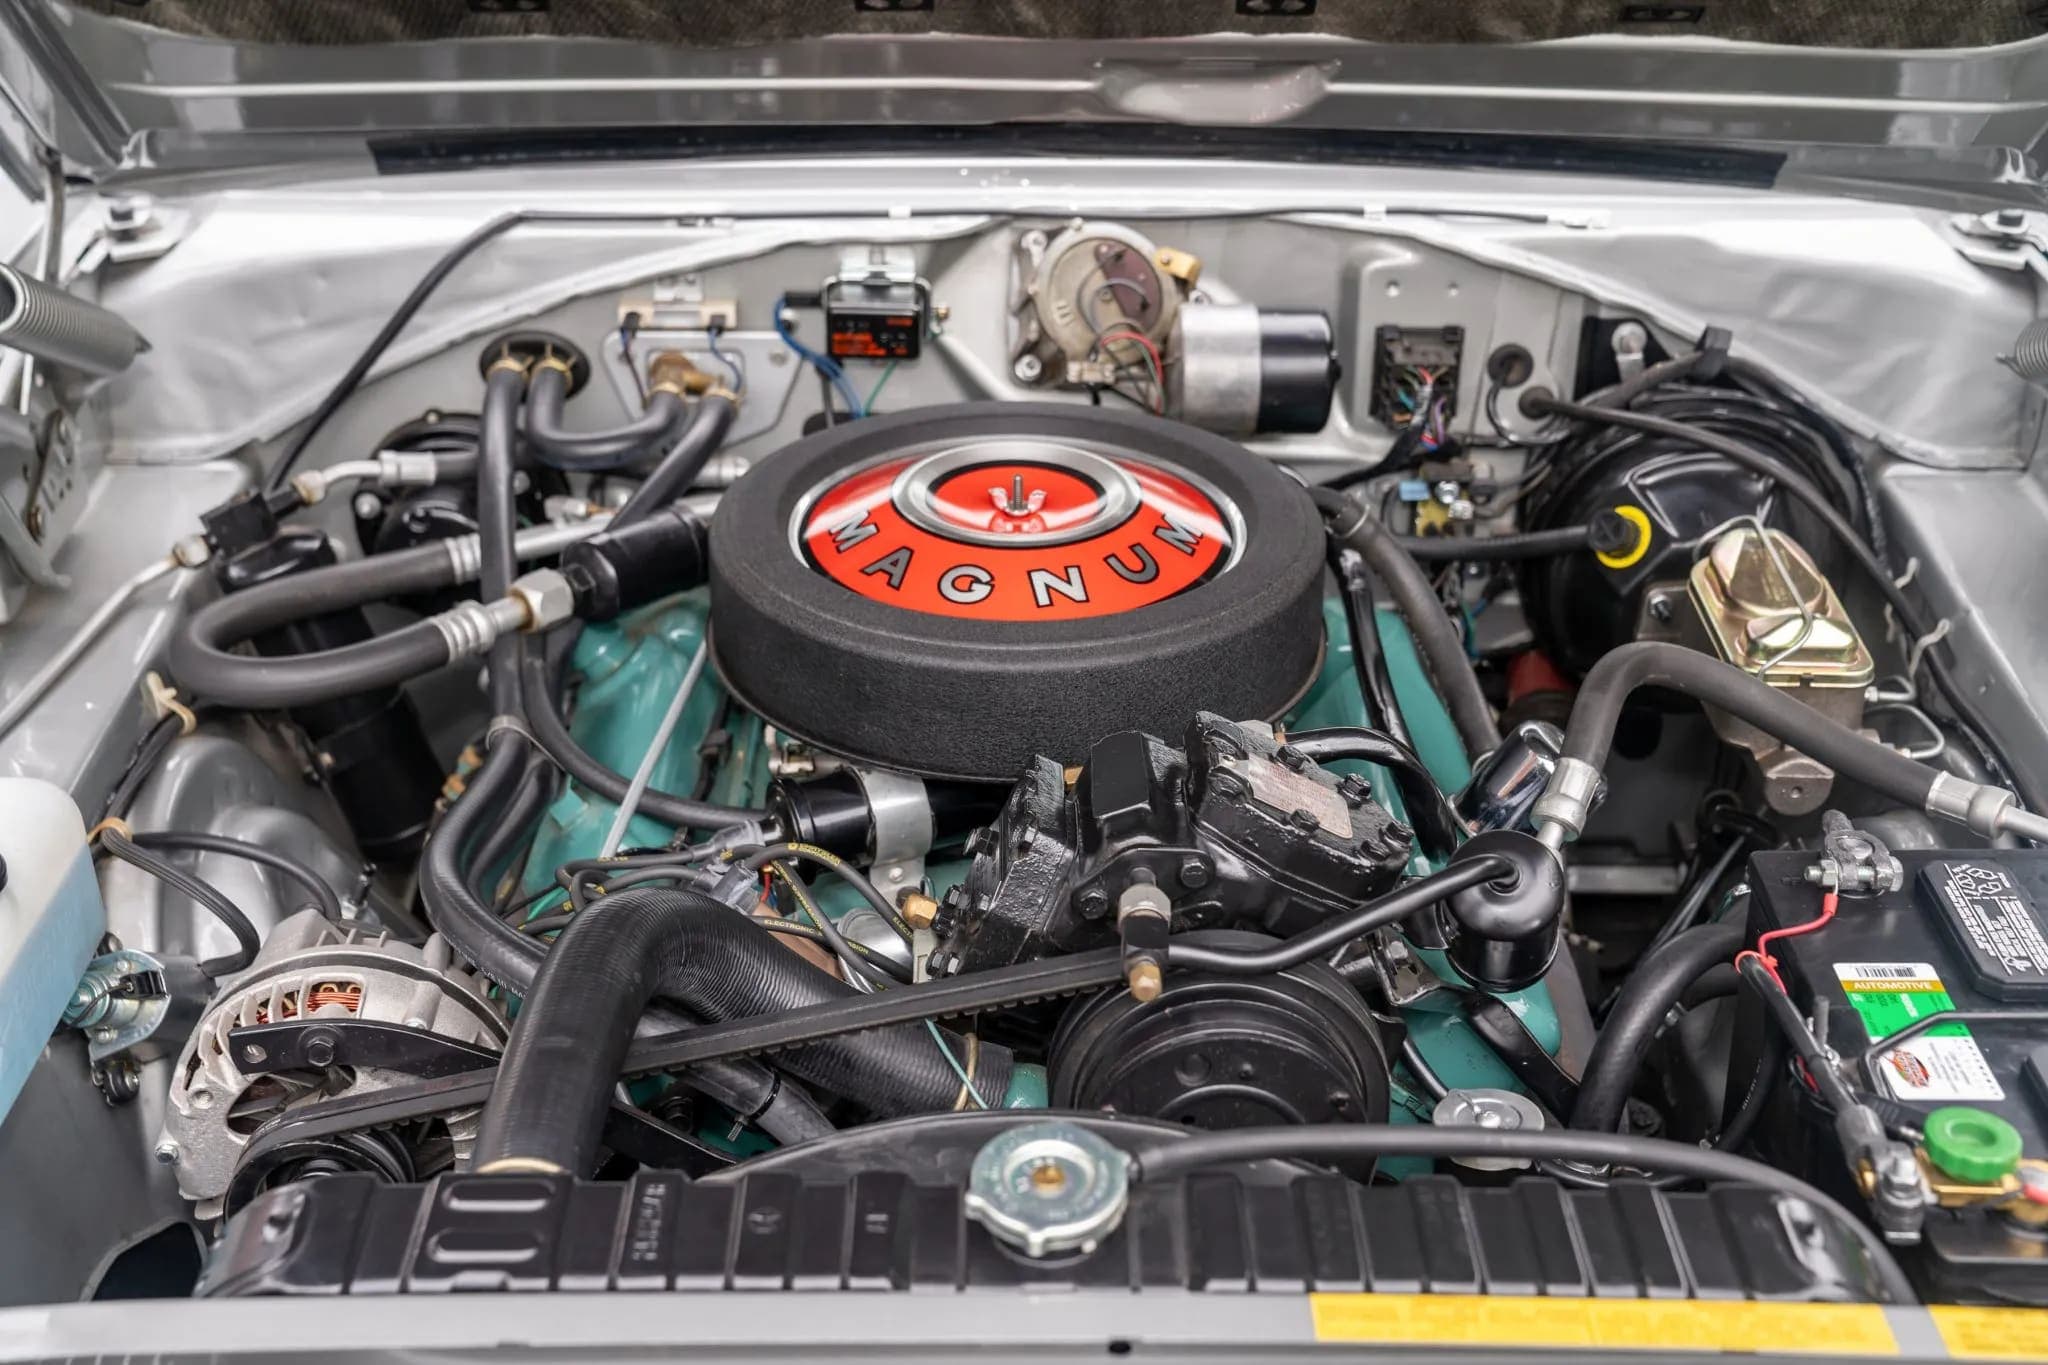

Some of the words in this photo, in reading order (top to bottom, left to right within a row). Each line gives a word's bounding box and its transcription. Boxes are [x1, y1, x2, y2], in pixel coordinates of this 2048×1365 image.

[827, 509, 1204, 608] MAGNUM
[764, 919, 814, 934] ELECTRONIC
[1853, 981, 1932, 990] AUTOMOTIVE
